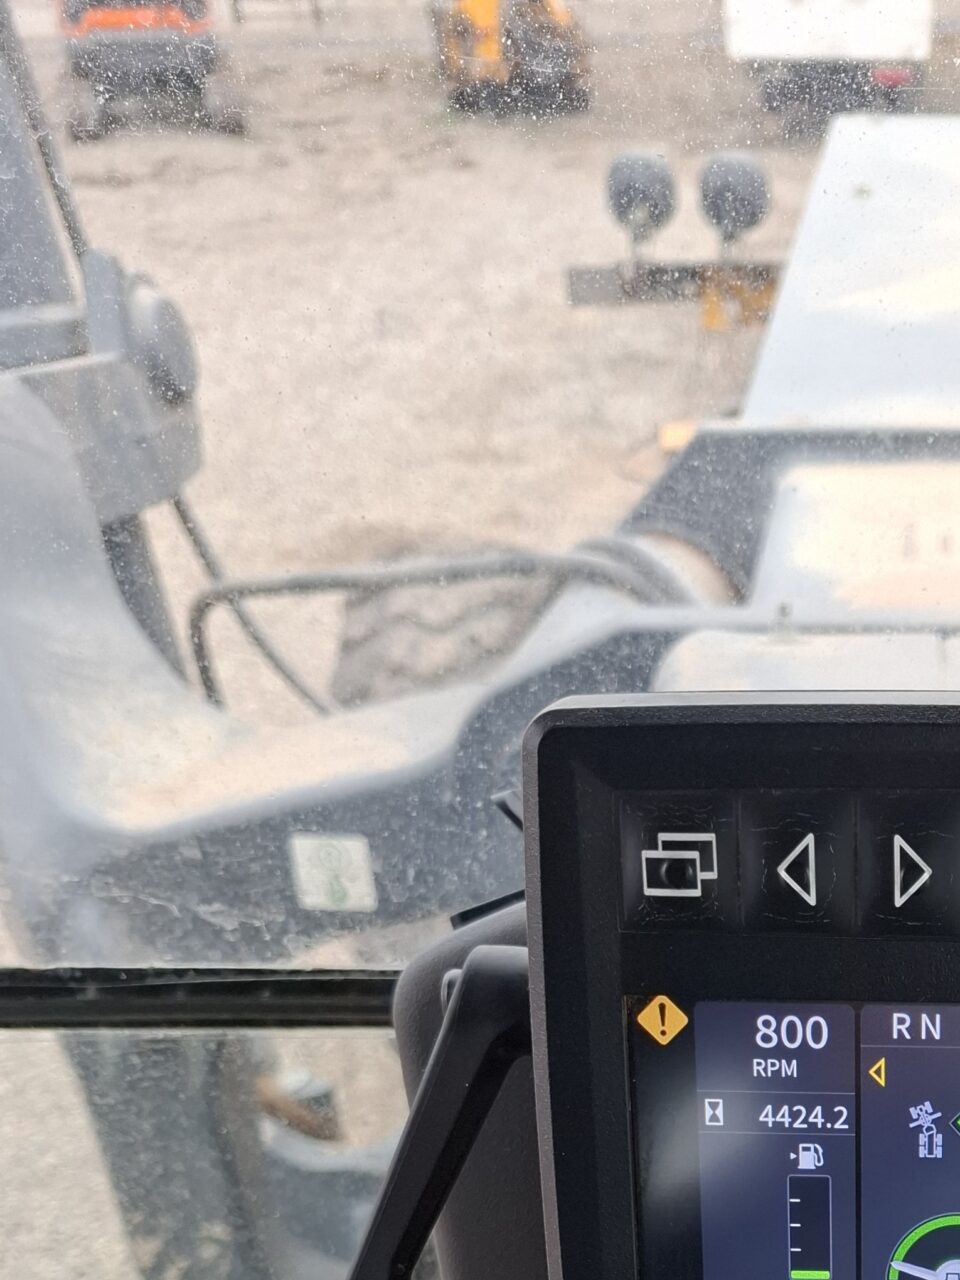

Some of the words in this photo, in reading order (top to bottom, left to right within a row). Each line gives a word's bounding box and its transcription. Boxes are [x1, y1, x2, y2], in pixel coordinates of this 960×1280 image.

[755, 1014, 829, 1050] 800
[752, 1058, 798, 1078] RPM
[758, 1104, 849, 1129] 4424.2
